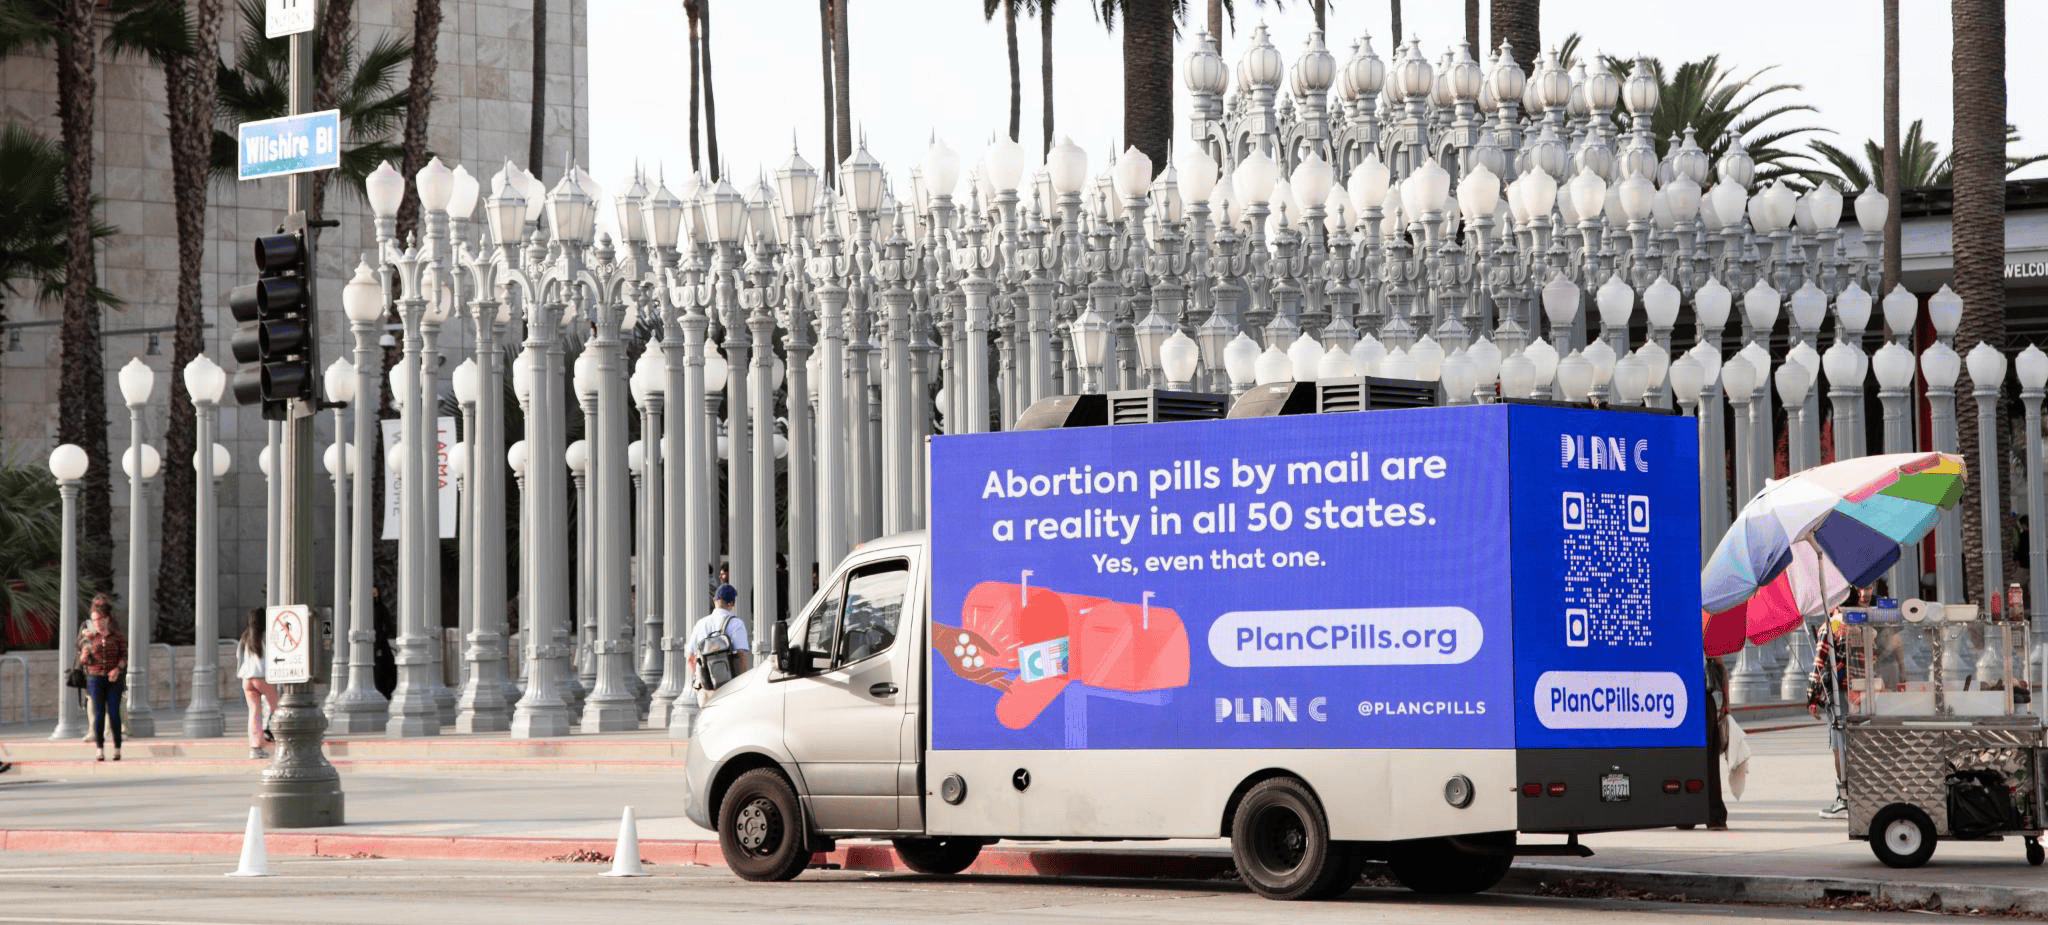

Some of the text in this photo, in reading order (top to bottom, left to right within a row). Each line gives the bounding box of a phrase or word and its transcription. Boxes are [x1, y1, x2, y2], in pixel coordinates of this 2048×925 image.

[245, 125, 333, 164] Wilshire Bl
[1561, 433, 1649, 473] PLAN C
[982, 451, 1447, 500] Abortion pills by mail are
[992, 497, 1437, 545] a reality in all 50 states.
[1091, 548, 1327, 577] Yes, even that one.
[1236, 624, 1457, 654] PlanCPills.org
[1215, 696, 1328, 723] PLAN C
[1357, 700, 1487, 717] @PLANCPILLS
[1551, 686, 1675, 719] PlanCPills.org
